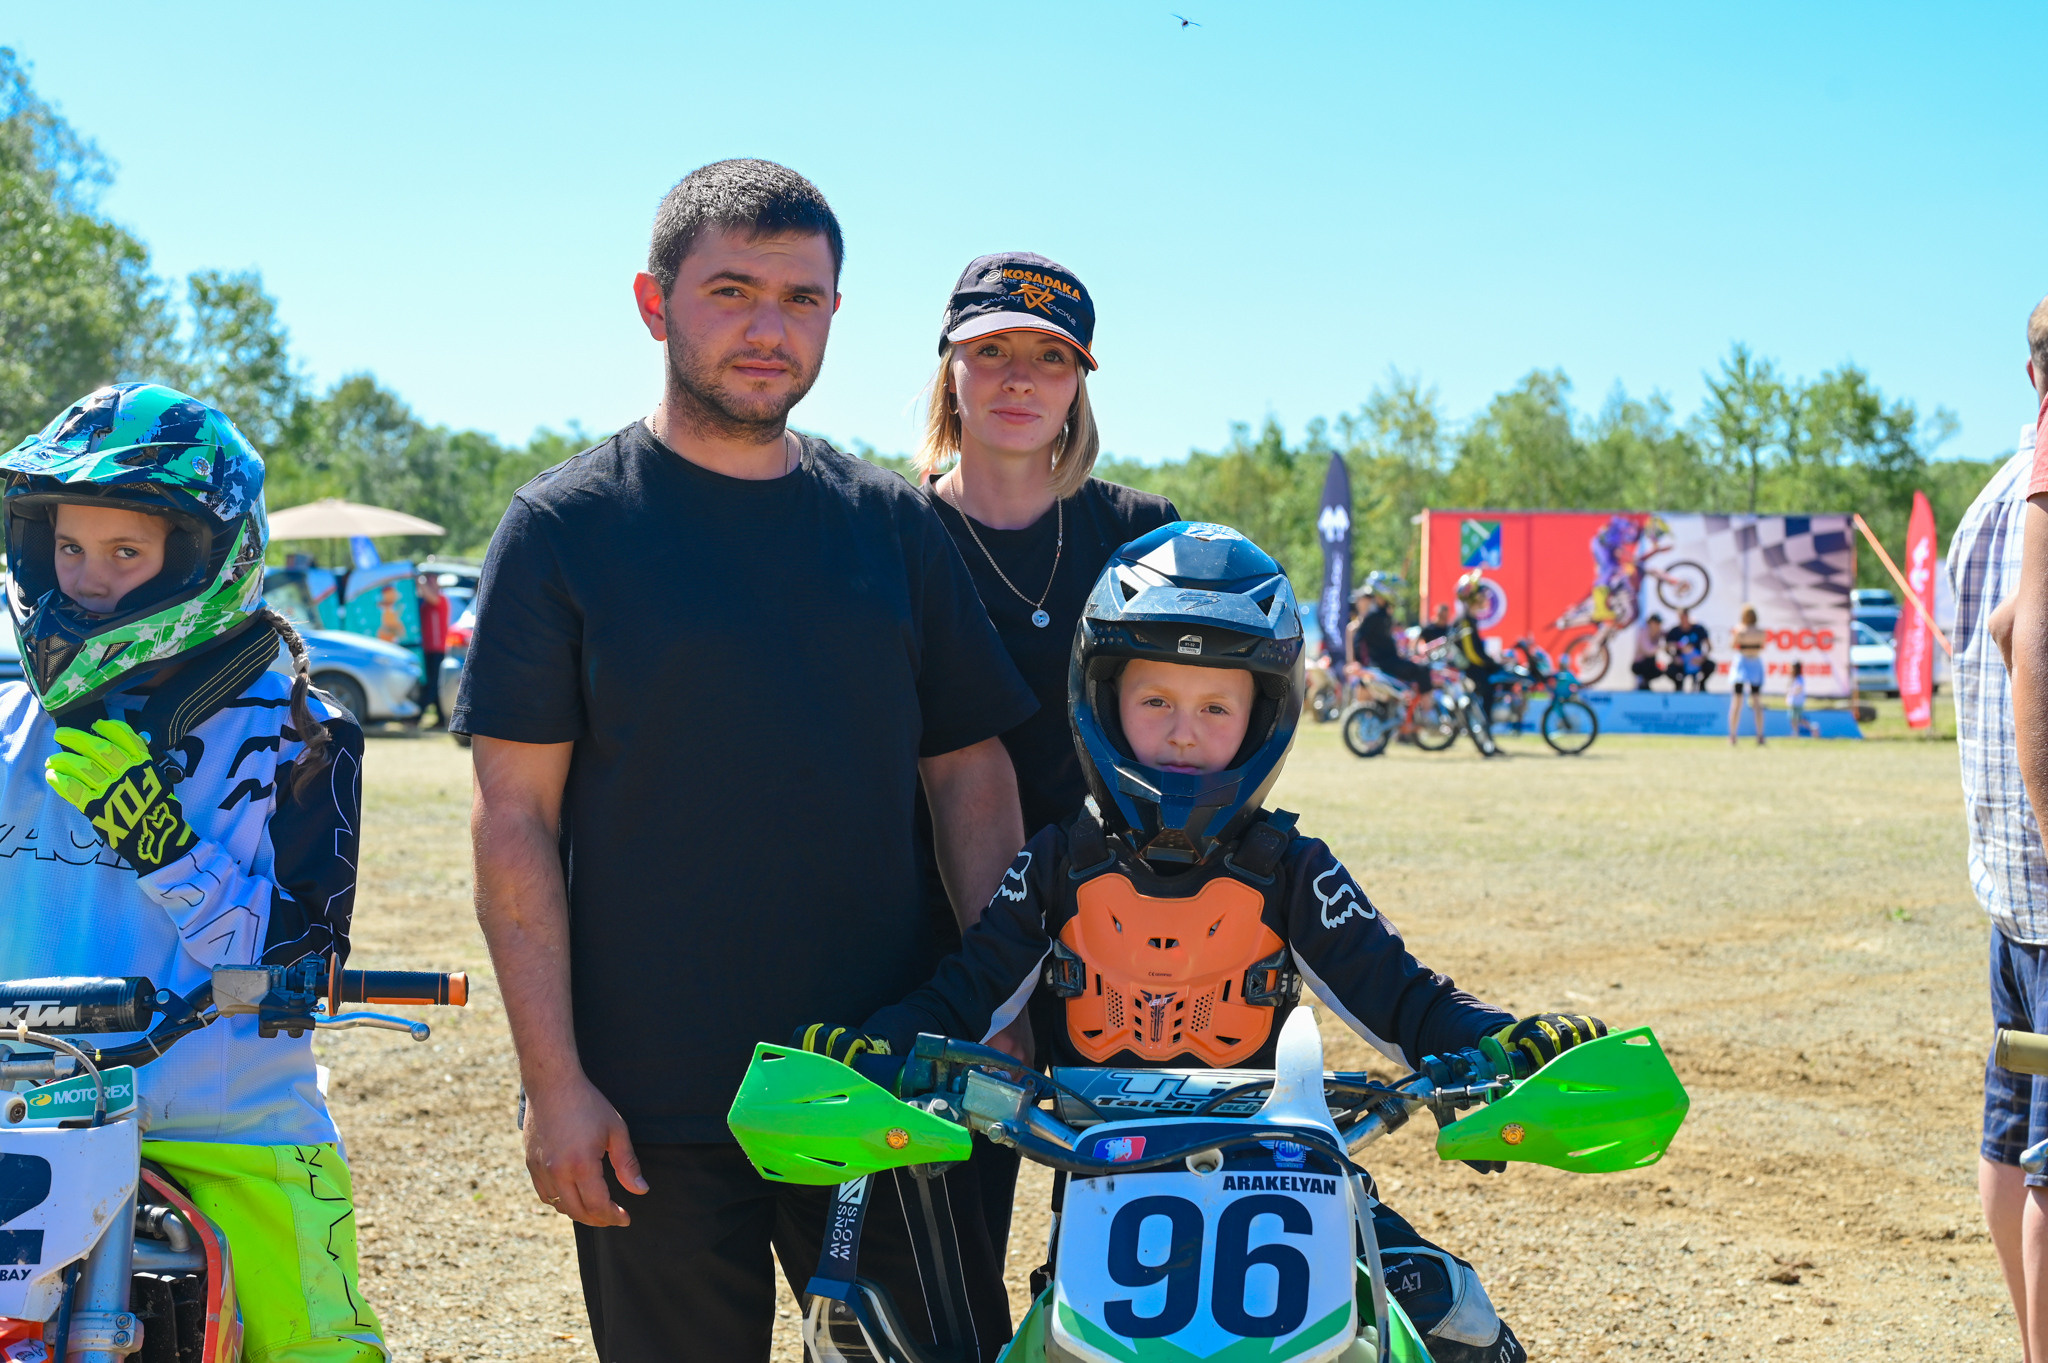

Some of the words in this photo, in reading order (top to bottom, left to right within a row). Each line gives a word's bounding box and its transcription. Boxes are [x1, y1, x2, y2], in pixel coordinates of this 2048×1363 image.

[1003, 268, 1081, 301] KOSADAKA
[1044, 302, 1077, 327] TACKLE
[92, 766, 162, 850] FOX
[0, 1000, 78, 1027] KTM
[1279, 1140, 1300, 1154] FIM
[1223, 1175, 1336, 1195] ARAKELYAN
[840, 1206, 858, 1260] SLOW
[1103, 1194, 1313, 1339] 96
